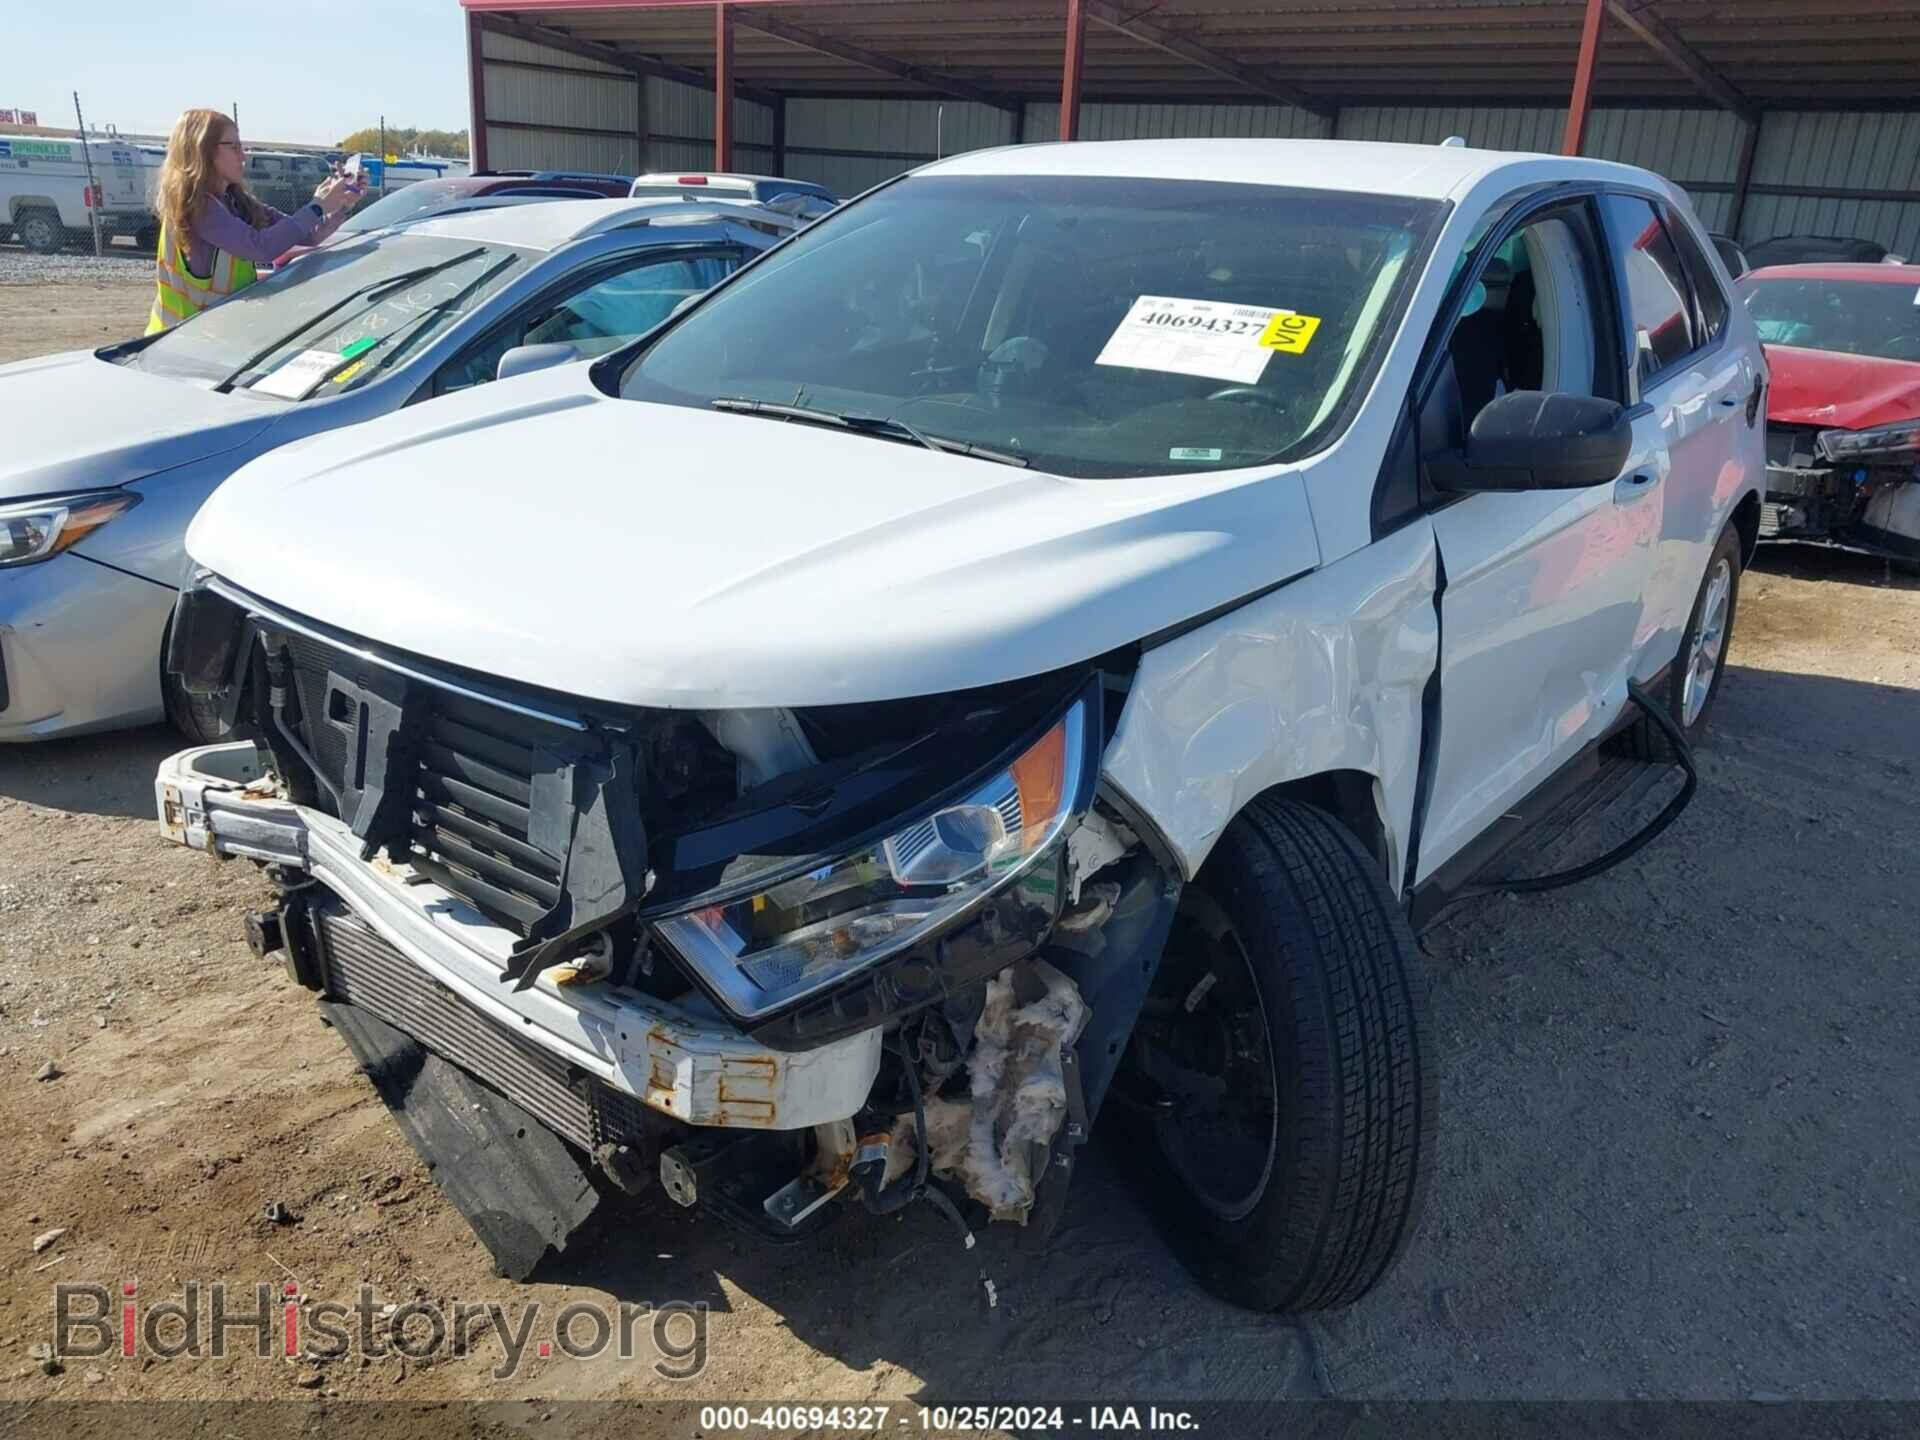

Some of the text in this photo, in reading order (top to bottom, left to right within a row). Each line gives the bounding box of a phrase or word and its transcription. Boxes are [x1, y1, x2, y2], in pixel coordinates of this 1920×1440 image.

[12, 142, 72, 155] SPRINKLER
[1141, 311, 1266, 337] 40694327
[1269, 317, 1307, 345] VIC
